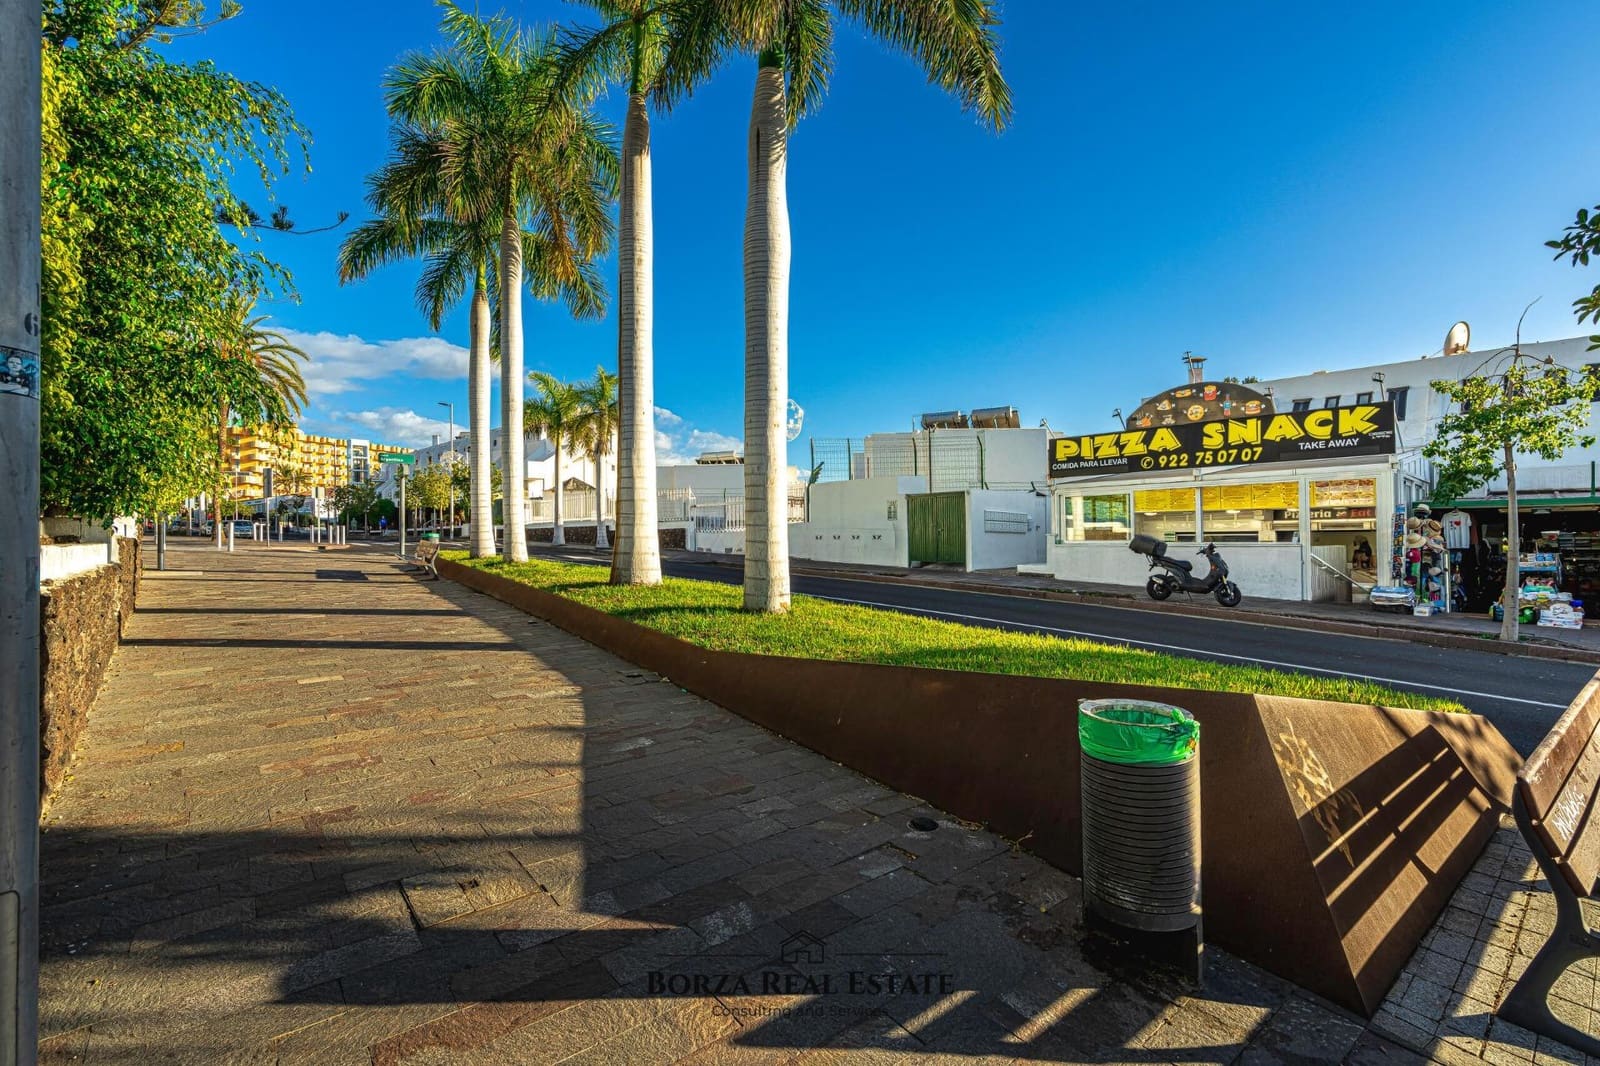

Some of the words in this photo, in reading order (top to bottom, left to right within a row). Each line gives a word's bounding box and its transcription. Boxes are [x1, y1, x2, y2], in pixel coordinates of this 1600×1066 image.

[1055, 427, 1182, 461] PIZZA
[1202, 406, 1380, 449] SNACK
[1298, 441, 1326, 450] TAKE
[1329, 438, 1360, 448] AWAY
[1079, 460, 1099, 468] PARA
[1100, 458, 1128, 466] LLEVAR
[1158, 453, 1189, 467] 922
[1195, 451, 1213, 465] 75
